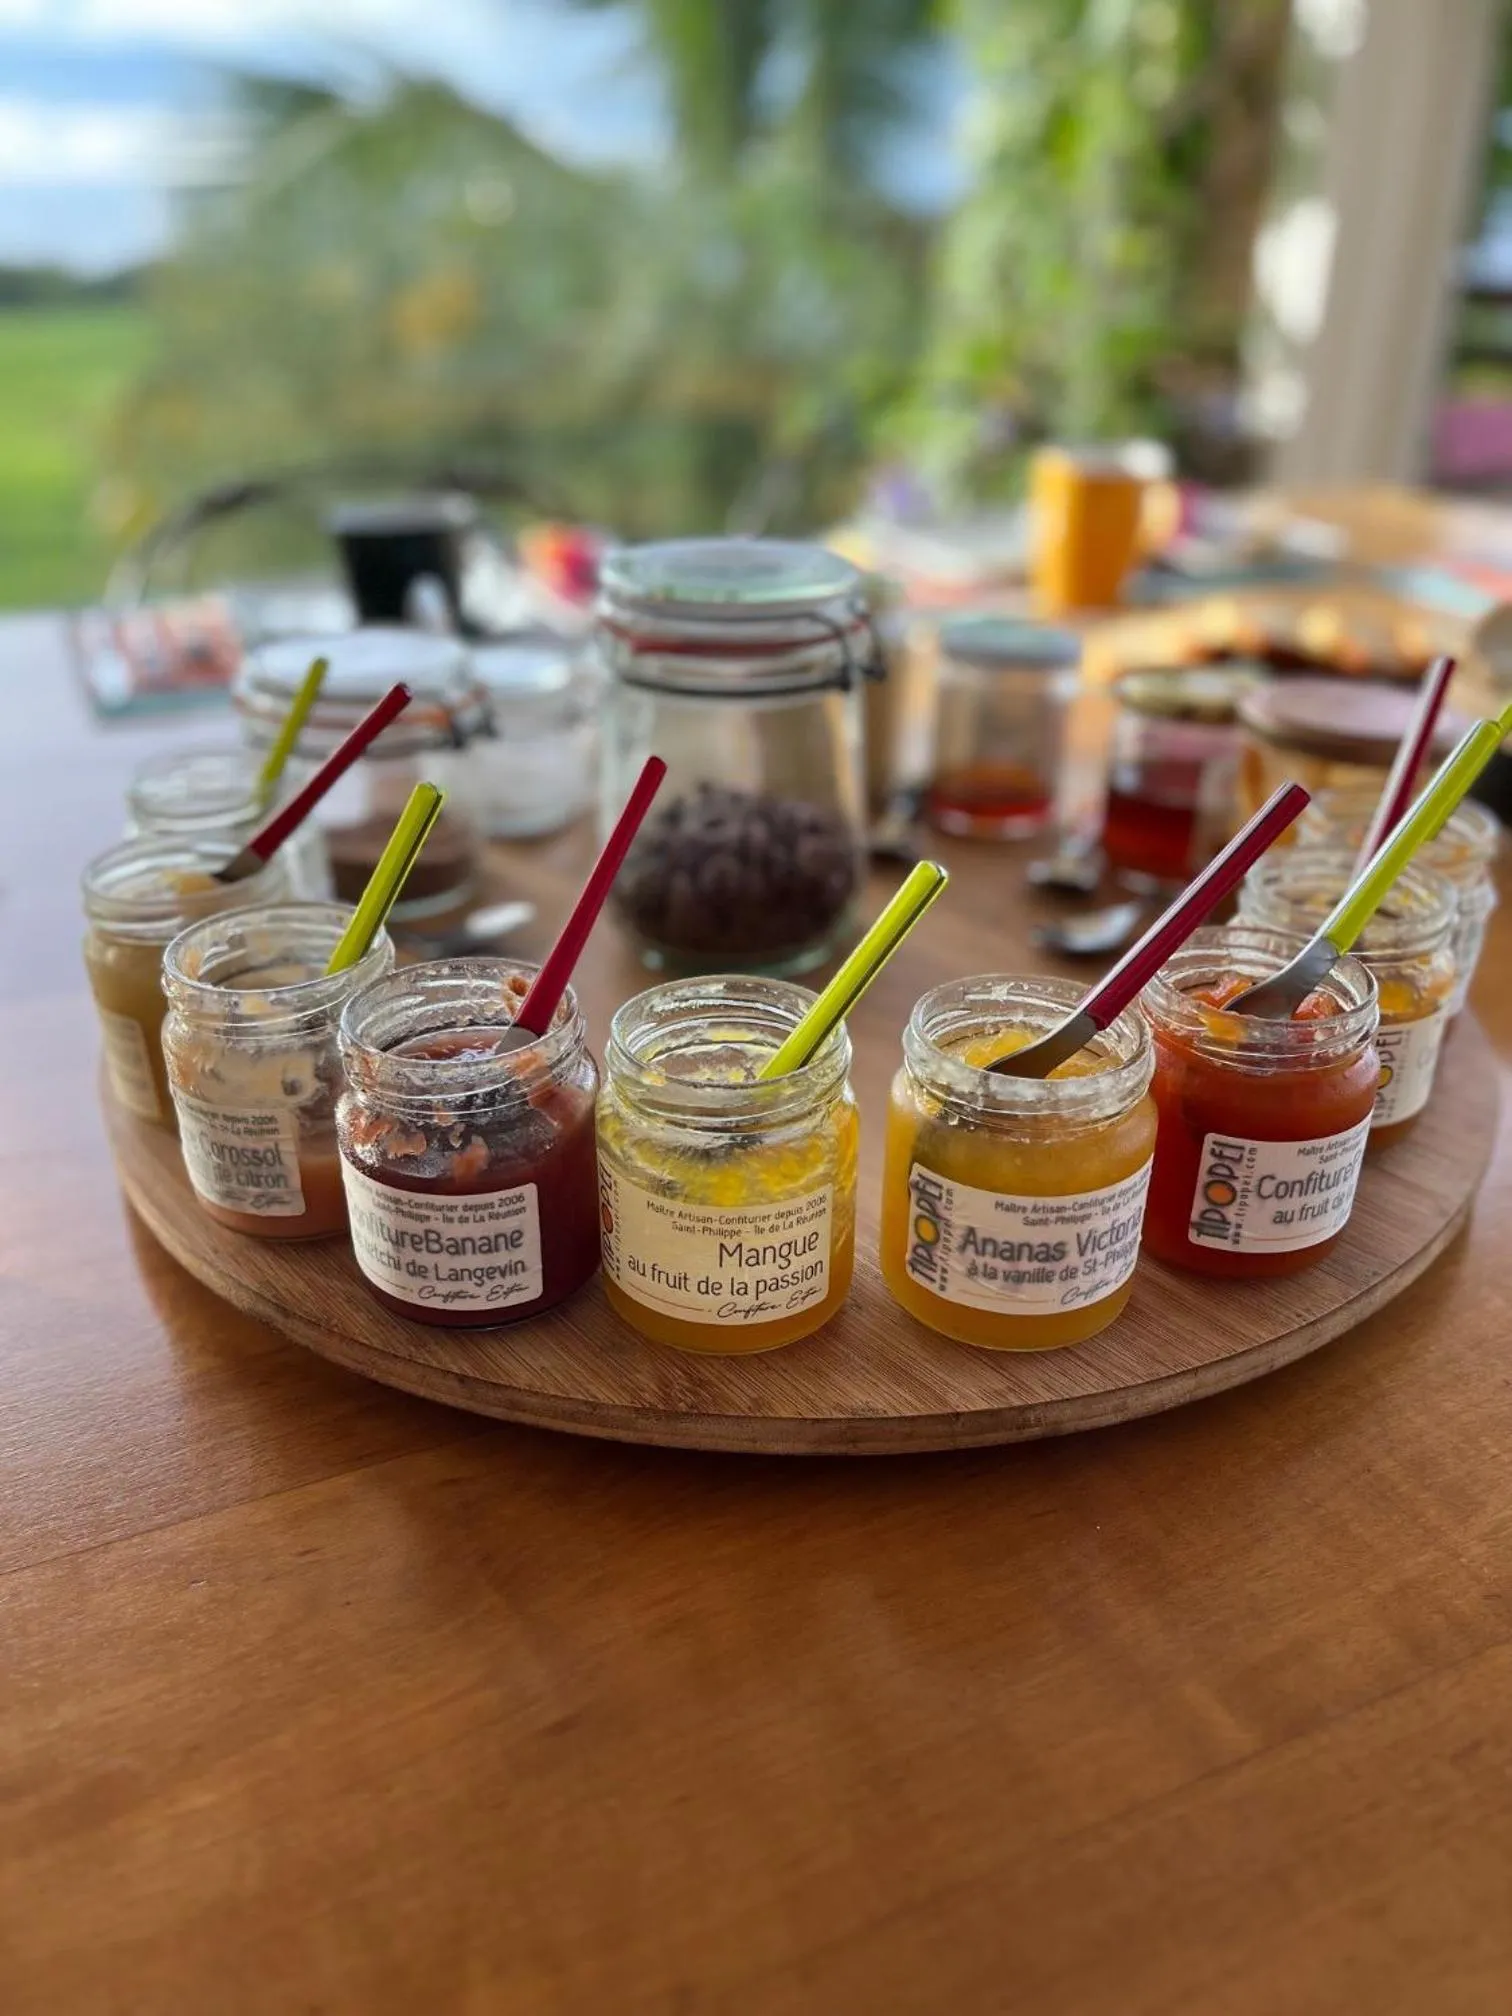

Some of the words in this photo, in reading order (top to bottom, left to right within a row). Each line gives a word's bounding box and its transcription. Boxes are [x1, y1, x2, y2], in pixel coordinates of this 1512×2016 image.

[236, 1168, 289, 1189] citron
[1256, 1162, 1354, 1200] Confiture
[498, 1193, 525, 1208] 2006
[775, 1206, 803, 1220] depuis
[1272, 1210, 1296, 1225] au
[1299, 1198, 1329, 1222] fruit
[768, 1223, 780, 1233] de
[783, 1220, 794, 1230] La
[719, 1231, 820, 1270] Mangue
[959, 1227, 1067, 1264] Ananas
[406, 1259, 429, 1279] de
[434, 1259, 526, 1287] Langevin
[628, 1255, 646, 1278] au
[651, 1263, 691, 1293] fruit
[696, 1279, 723, 1296] de
[730, 1277, 748, 1296] la
[756, 1259, 823, 1300] passion
[967, 1257, 979, 1278] à
[983, 1261, 999, 1281] la
[1003, 1265, 1055, 1284] vanille
[1059, 1264, 1079, 1281] de
